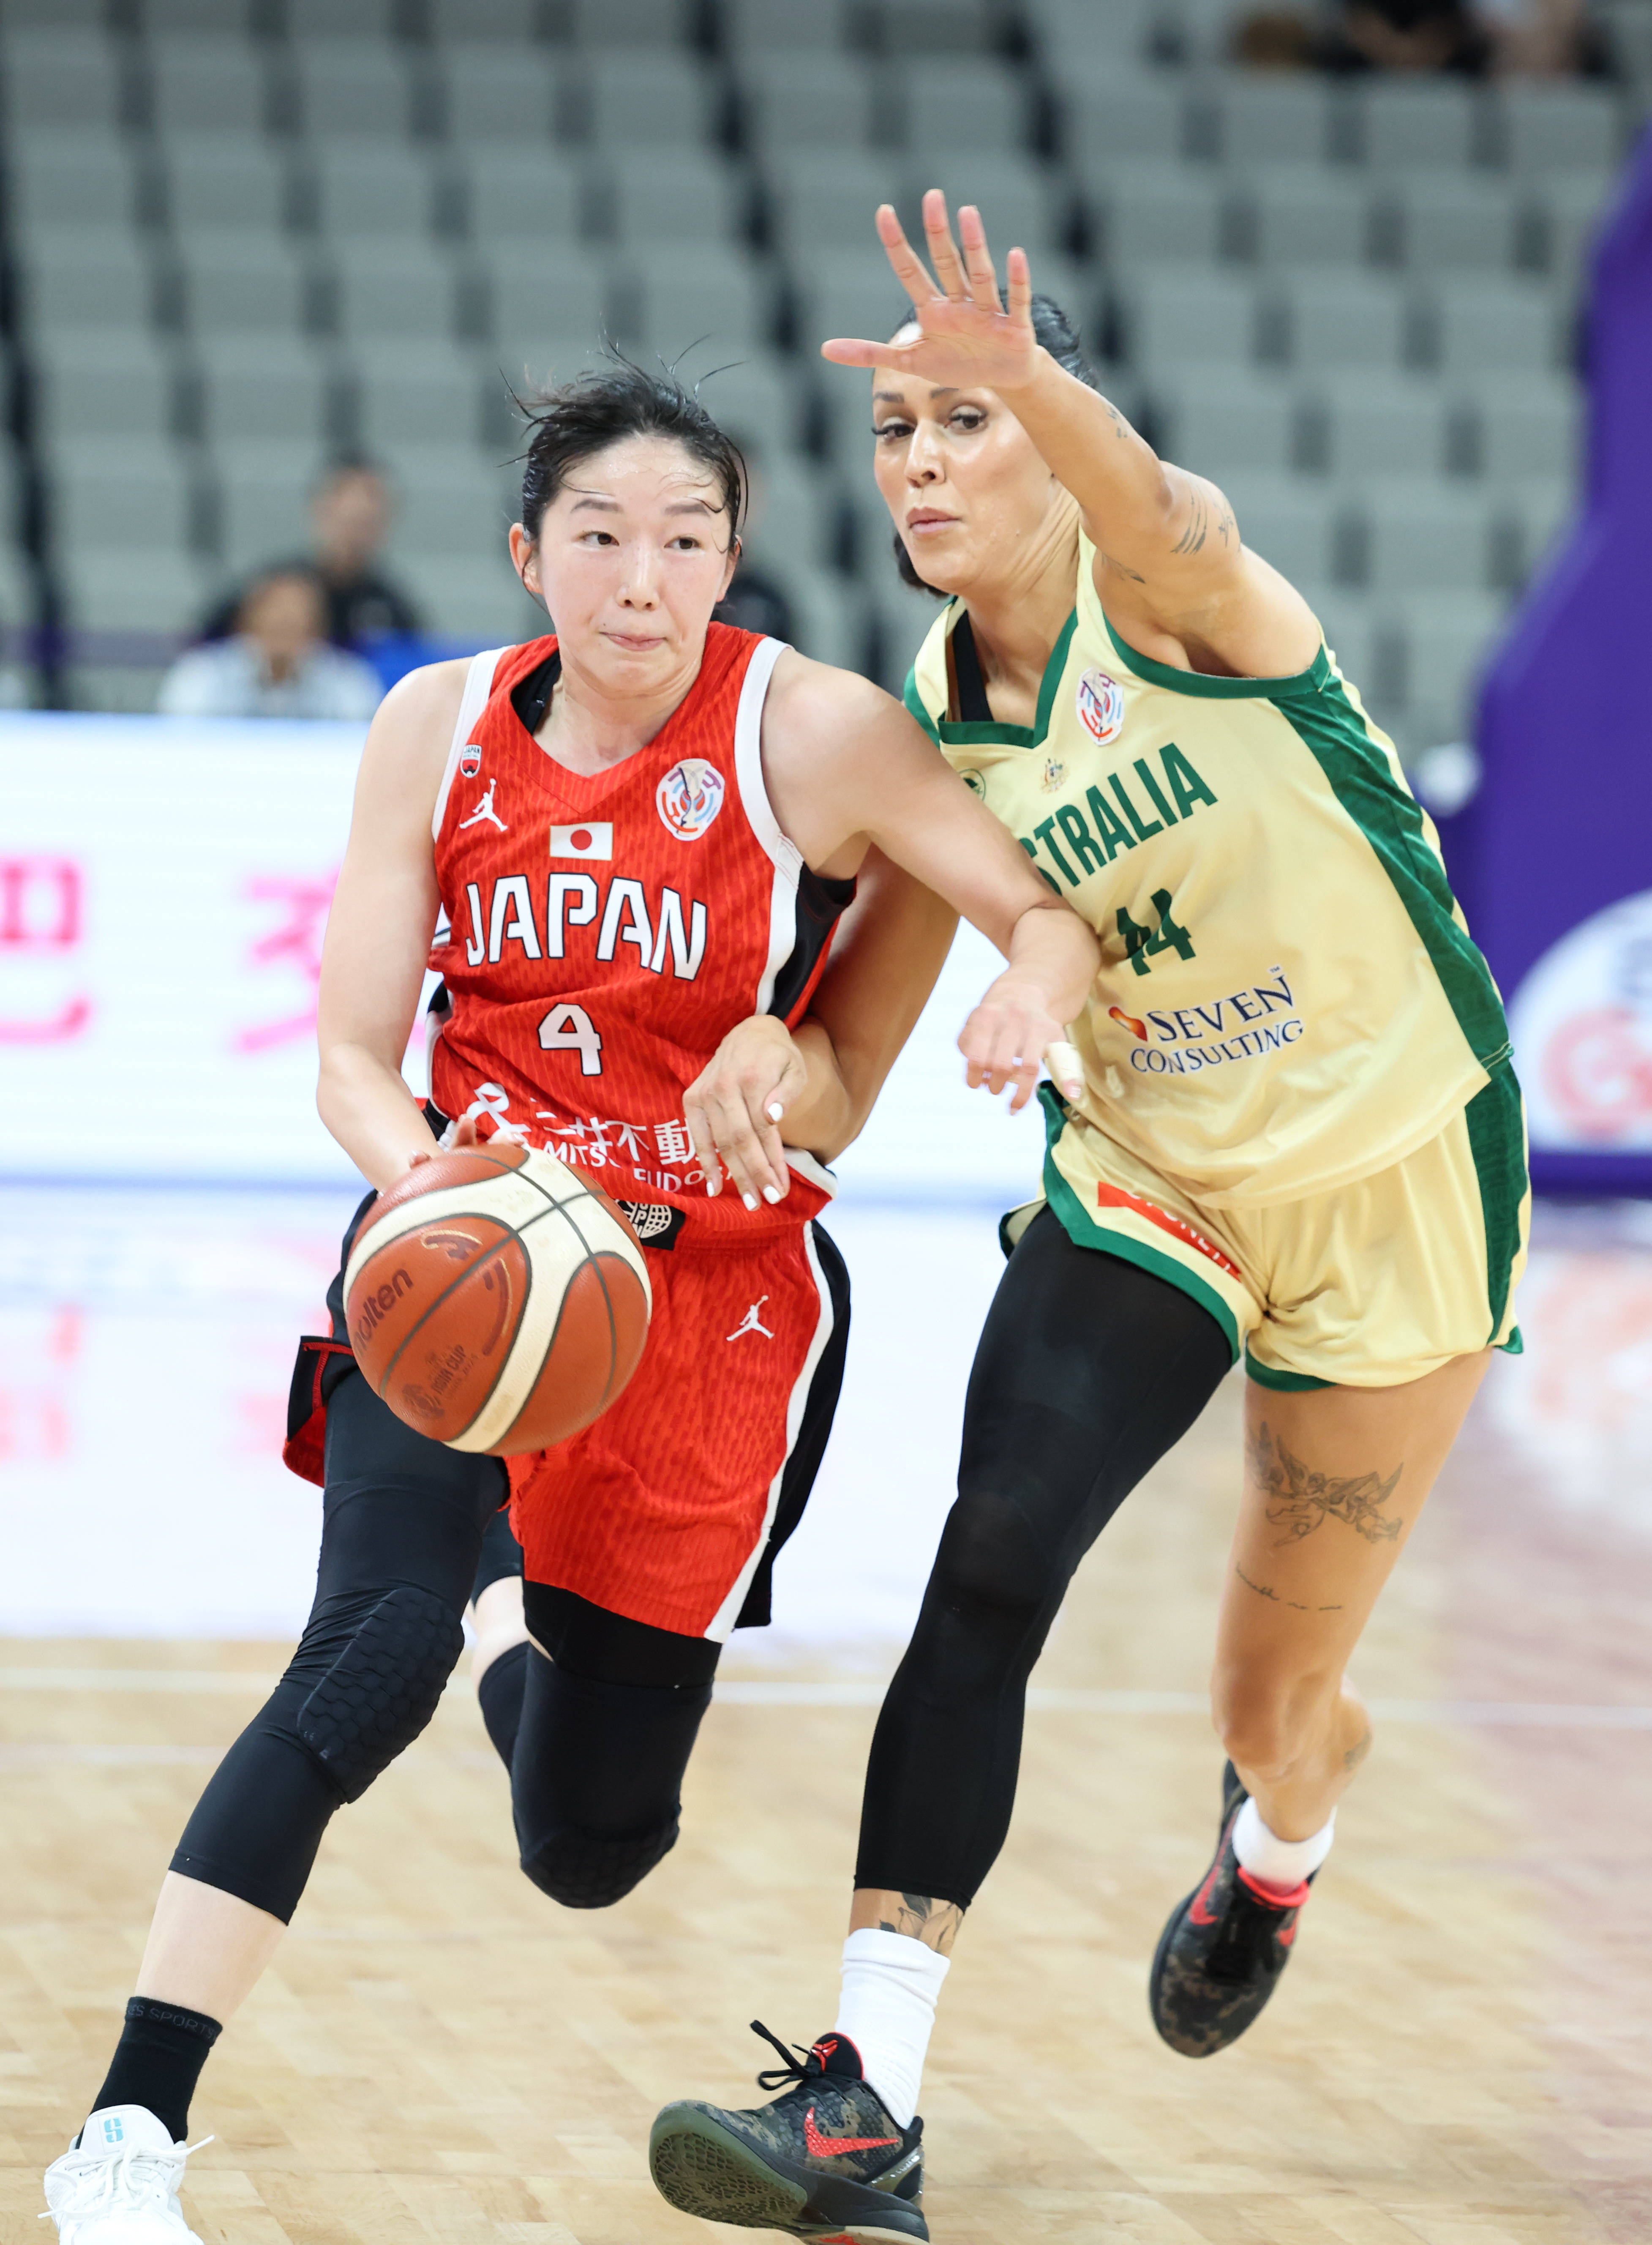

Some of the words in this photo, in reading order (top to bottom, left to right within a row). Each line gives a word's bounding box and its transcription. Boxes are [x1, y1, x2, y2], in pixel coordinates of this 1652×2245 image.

[466, 872, 707, 982] JAPAN
[1116, 888, 1196, 976] 44
[537, 1003, 602, 1076] 4
[1146, 974, 1293, 1042] SEVEN
[1130, 1020, 1304, 1073] CONSULTING
[530, 1098, 721, 1165] 三井不動
[542, 1140, 621, 1168] MITS
